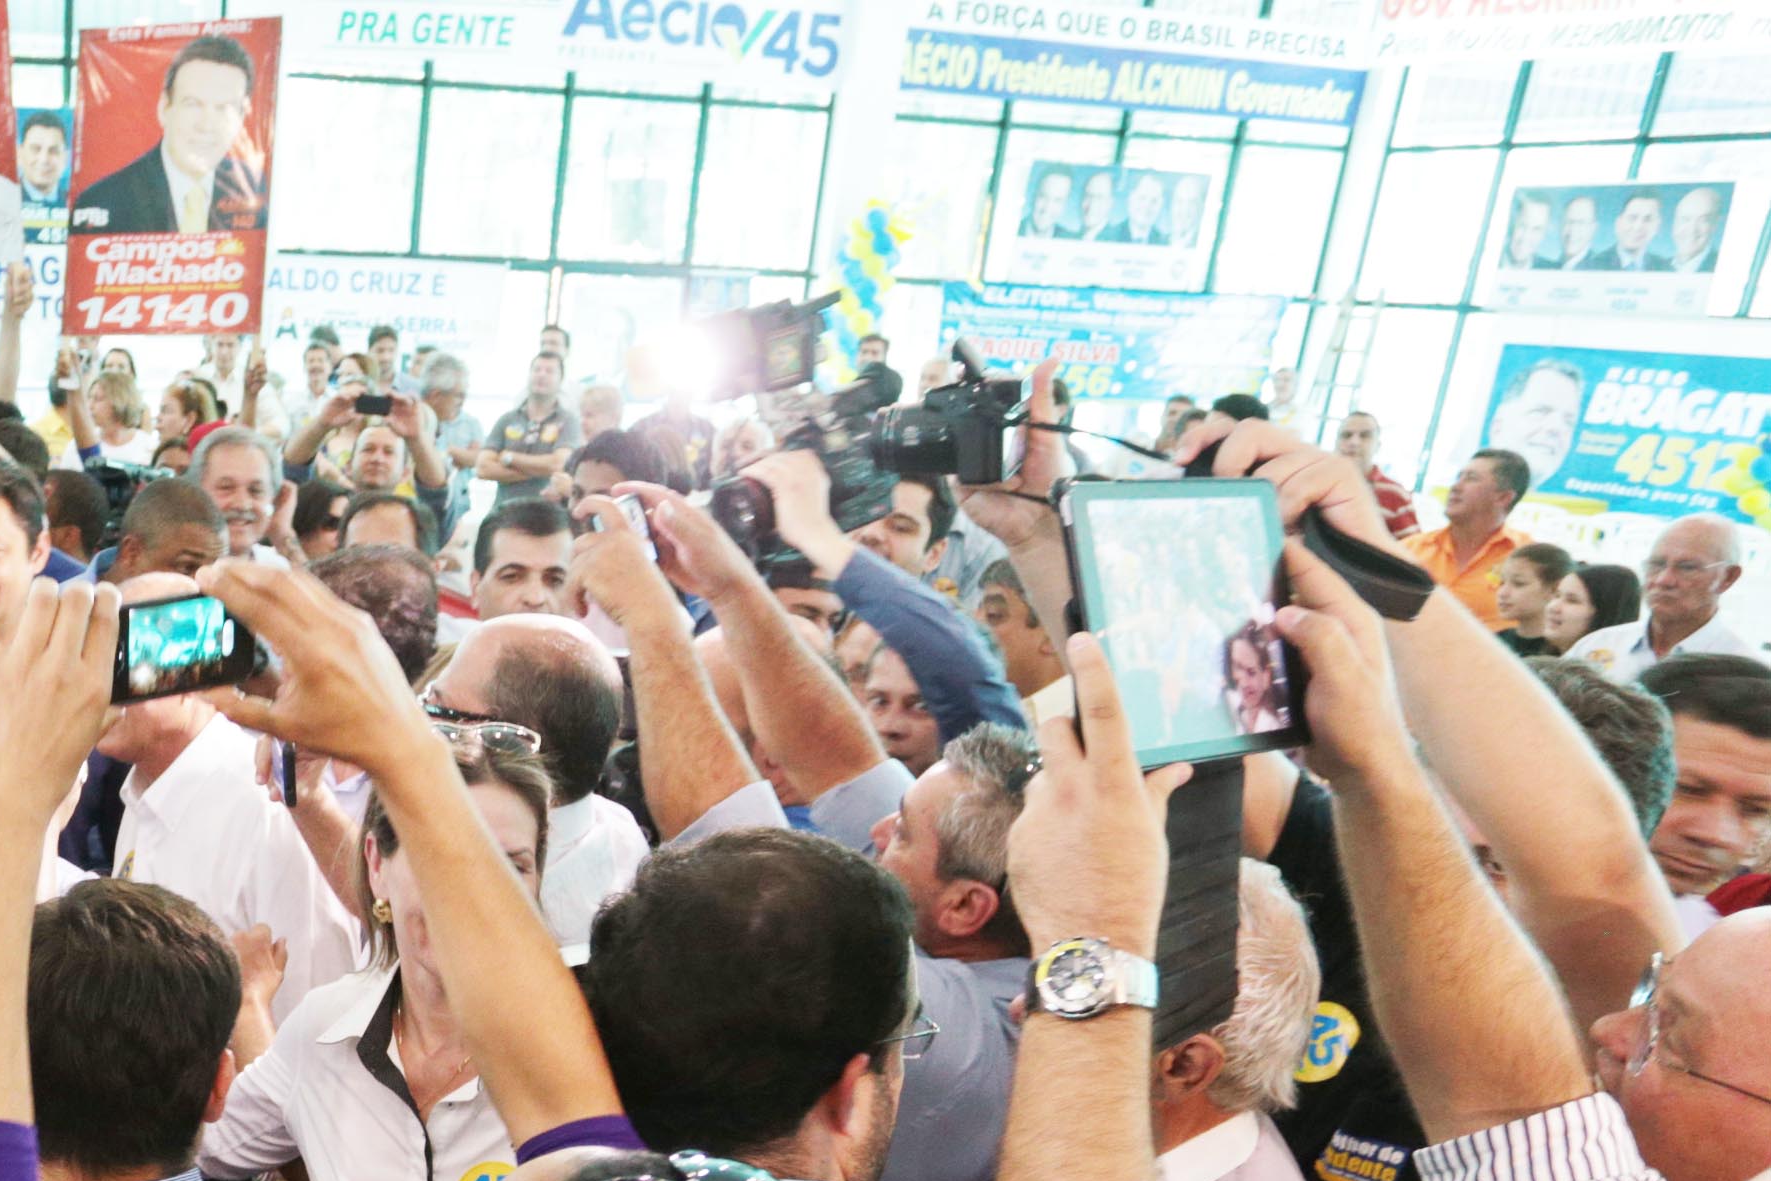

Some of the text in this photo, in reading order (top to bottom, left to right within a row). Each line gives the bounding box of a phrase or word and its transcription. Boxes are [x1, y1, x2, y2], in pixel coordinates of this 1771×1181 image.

[335, 11, 514, 47] PRA GENTE
[762, 11, 842, 77] 45
[955, 2, 1046, 39] FORÇA
[1058, 12, 1108, 38] QUE
[1119, 16, 1137, 38] O
[1146, 18, 1235, 48] BRASIL
[1247, 30, 1347, 58] PRECISA
[978, 46, 1111, 101] Presidente
[1111, 59, 1226, 109] ALCKMIN
[1225, 70, 1355, 121] Governador
[85, 237, 216, 265] Campos
[95, 255, 245, 285] Machado
[350, 270, 423, 296] CRUZ
[76, 291, 250, 329] 14140
[1051, 340, 1120, 363] SILVA
